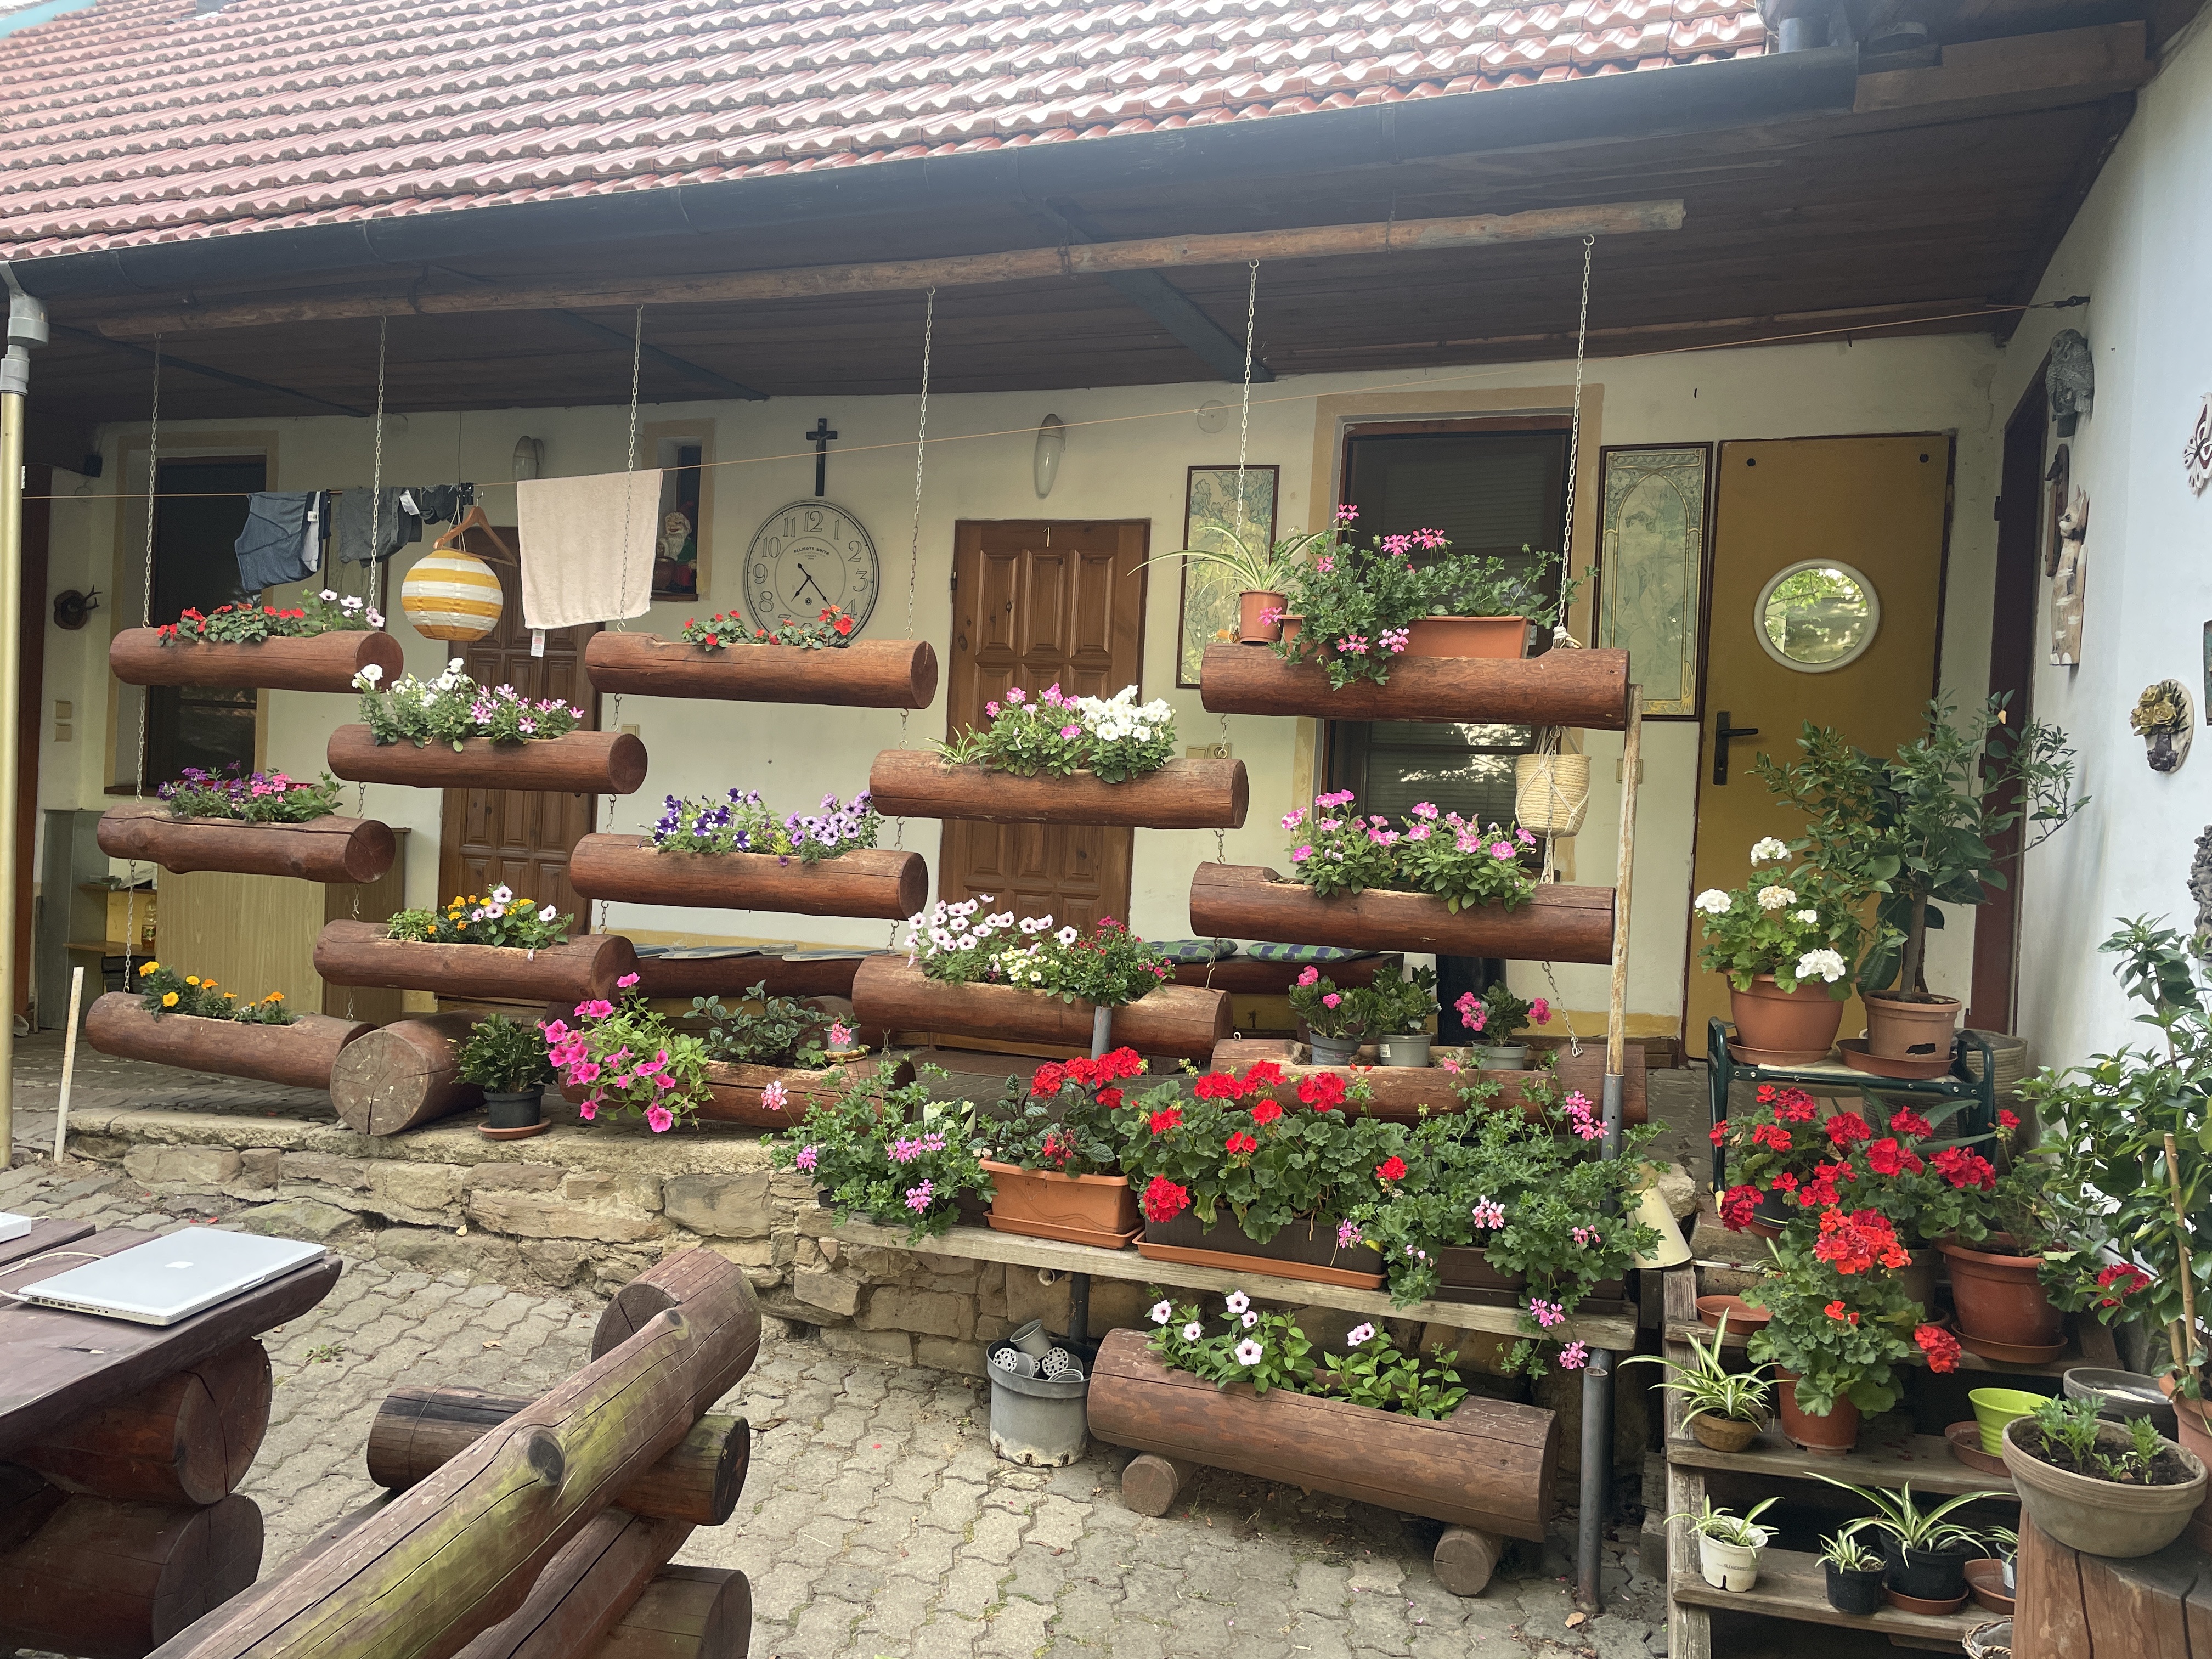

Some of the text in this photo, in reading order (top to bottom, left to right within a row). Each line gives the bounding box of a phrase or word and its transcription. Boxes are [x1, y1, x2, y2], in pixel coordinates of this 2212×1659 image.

[783, 516, 796, 538] 11
[803, 511, 823, 533] 12
[833, 518, 839, 540] 1
[761, 537, 781, 558] 10
[1043, 527, 1050, 548] 1
[848, 540, 862, 562] 2
[753, 563, 768, 584] 9
[852, 570, 868, 592] 3
[758, 591, 774, 613] 8
[842, 598, 858, 619] 4
